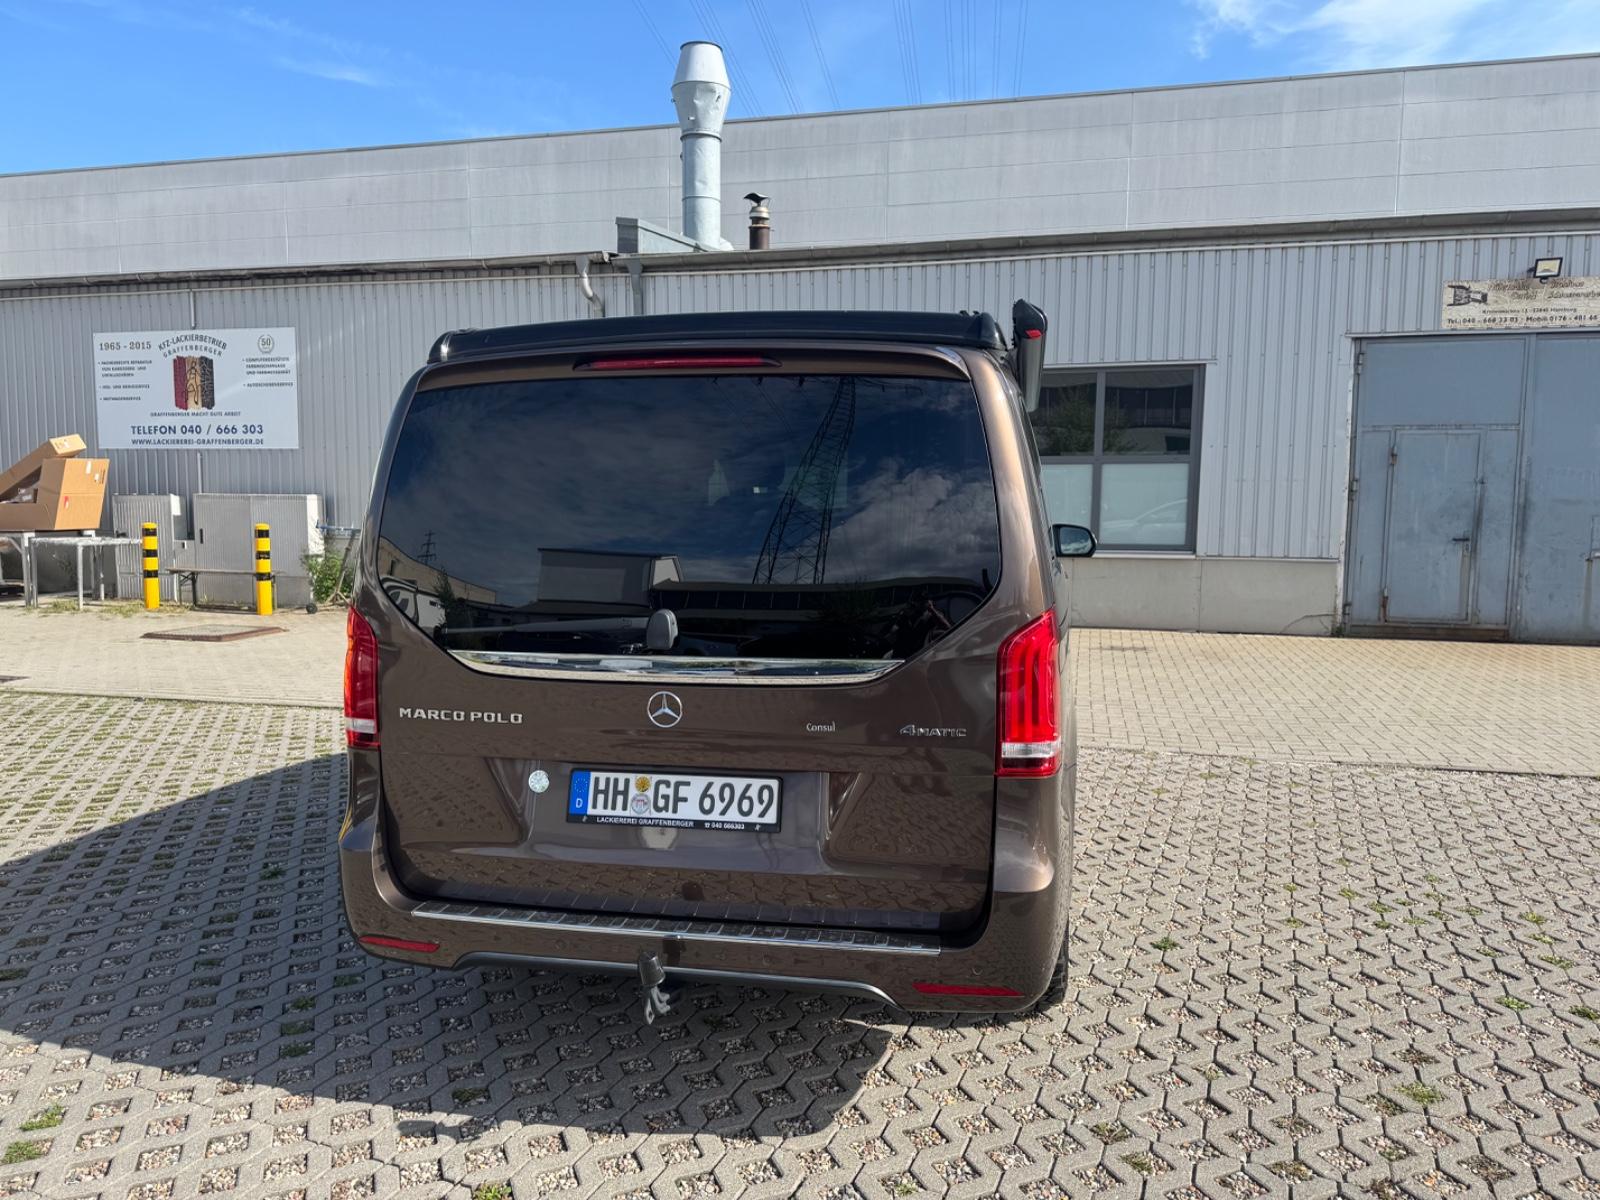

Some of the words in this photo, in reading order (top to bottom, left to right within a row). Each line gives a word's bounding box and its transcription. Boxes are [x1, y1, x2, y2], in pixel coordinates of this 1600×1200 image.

[99, 341, 121, 351] 1965
[128, 341, 151, 350] 2015
[158, 334, 227, 351] KFZ-LACKIERBETRIEB
[261, 338, 271, 346] 50
[163, 345, 223, 358] GRAFFENBERGER
[131, 425, 176, 435] TELEFON
[180, 425, 202, 435] 040
[216, 424, 238, 435] 666
[242, 424, 263, 434] 303
[131, 438, 263, 446] WWW.LACKIEREREI-GRAFFENBERGER.DE
[399, 707, 466, 721] MARCO
[470, 711, 523, 724] POLO
[806, 721, 836, 732] Consul
[900, 724, 967, 737] 4MATIC
[575, 798, 583, 808] D
[591, 776, 631, 812] HH
[652, 779, 691, 814] GF
[698, 781, 774, 818] 6969
[596, 816, 638, 825] LACKIEREREI
[638, 818, 694, 829] GRAFFENBERGER
